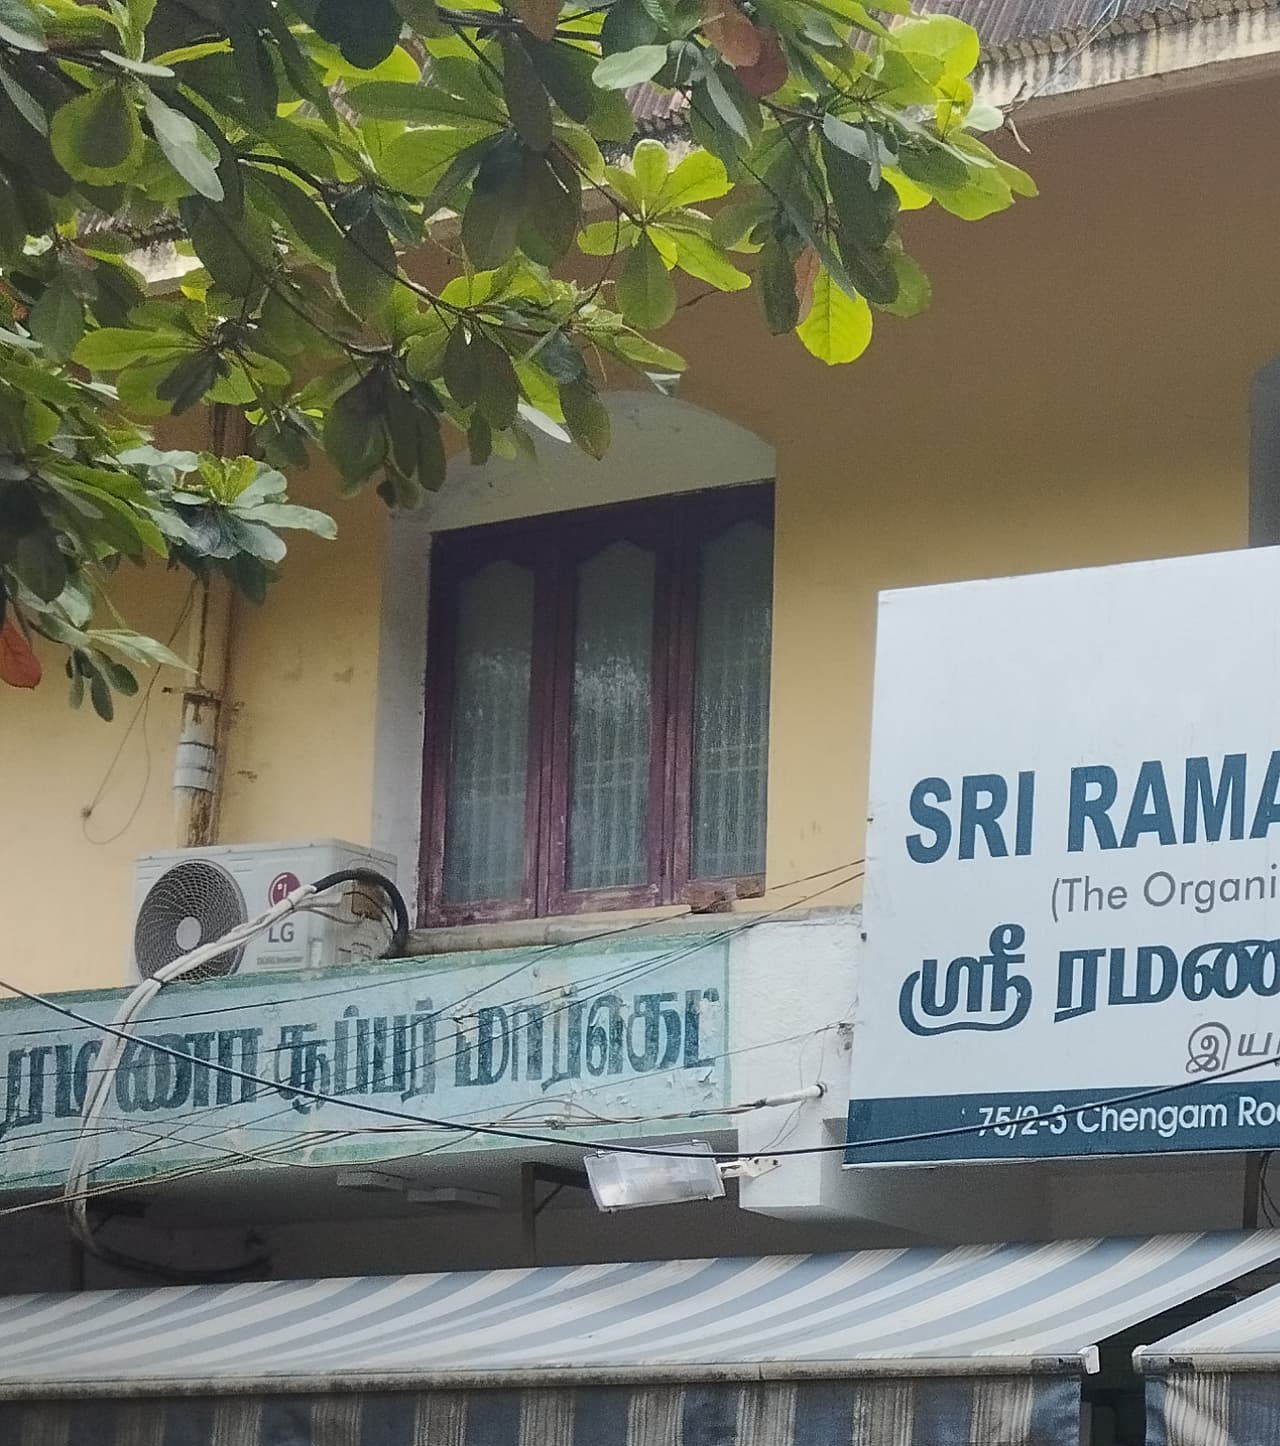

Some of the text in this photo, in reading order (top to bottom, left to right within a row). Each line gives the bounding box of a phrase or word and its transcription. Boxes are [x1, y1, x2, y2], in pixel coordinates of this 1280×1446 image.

[905, 770, 1036, 864] SRI
[1050, 876, 1129, 923] (The
[268, 922, 295, 944] LG
[1075, 1098, 1228, 1139] Chengam
